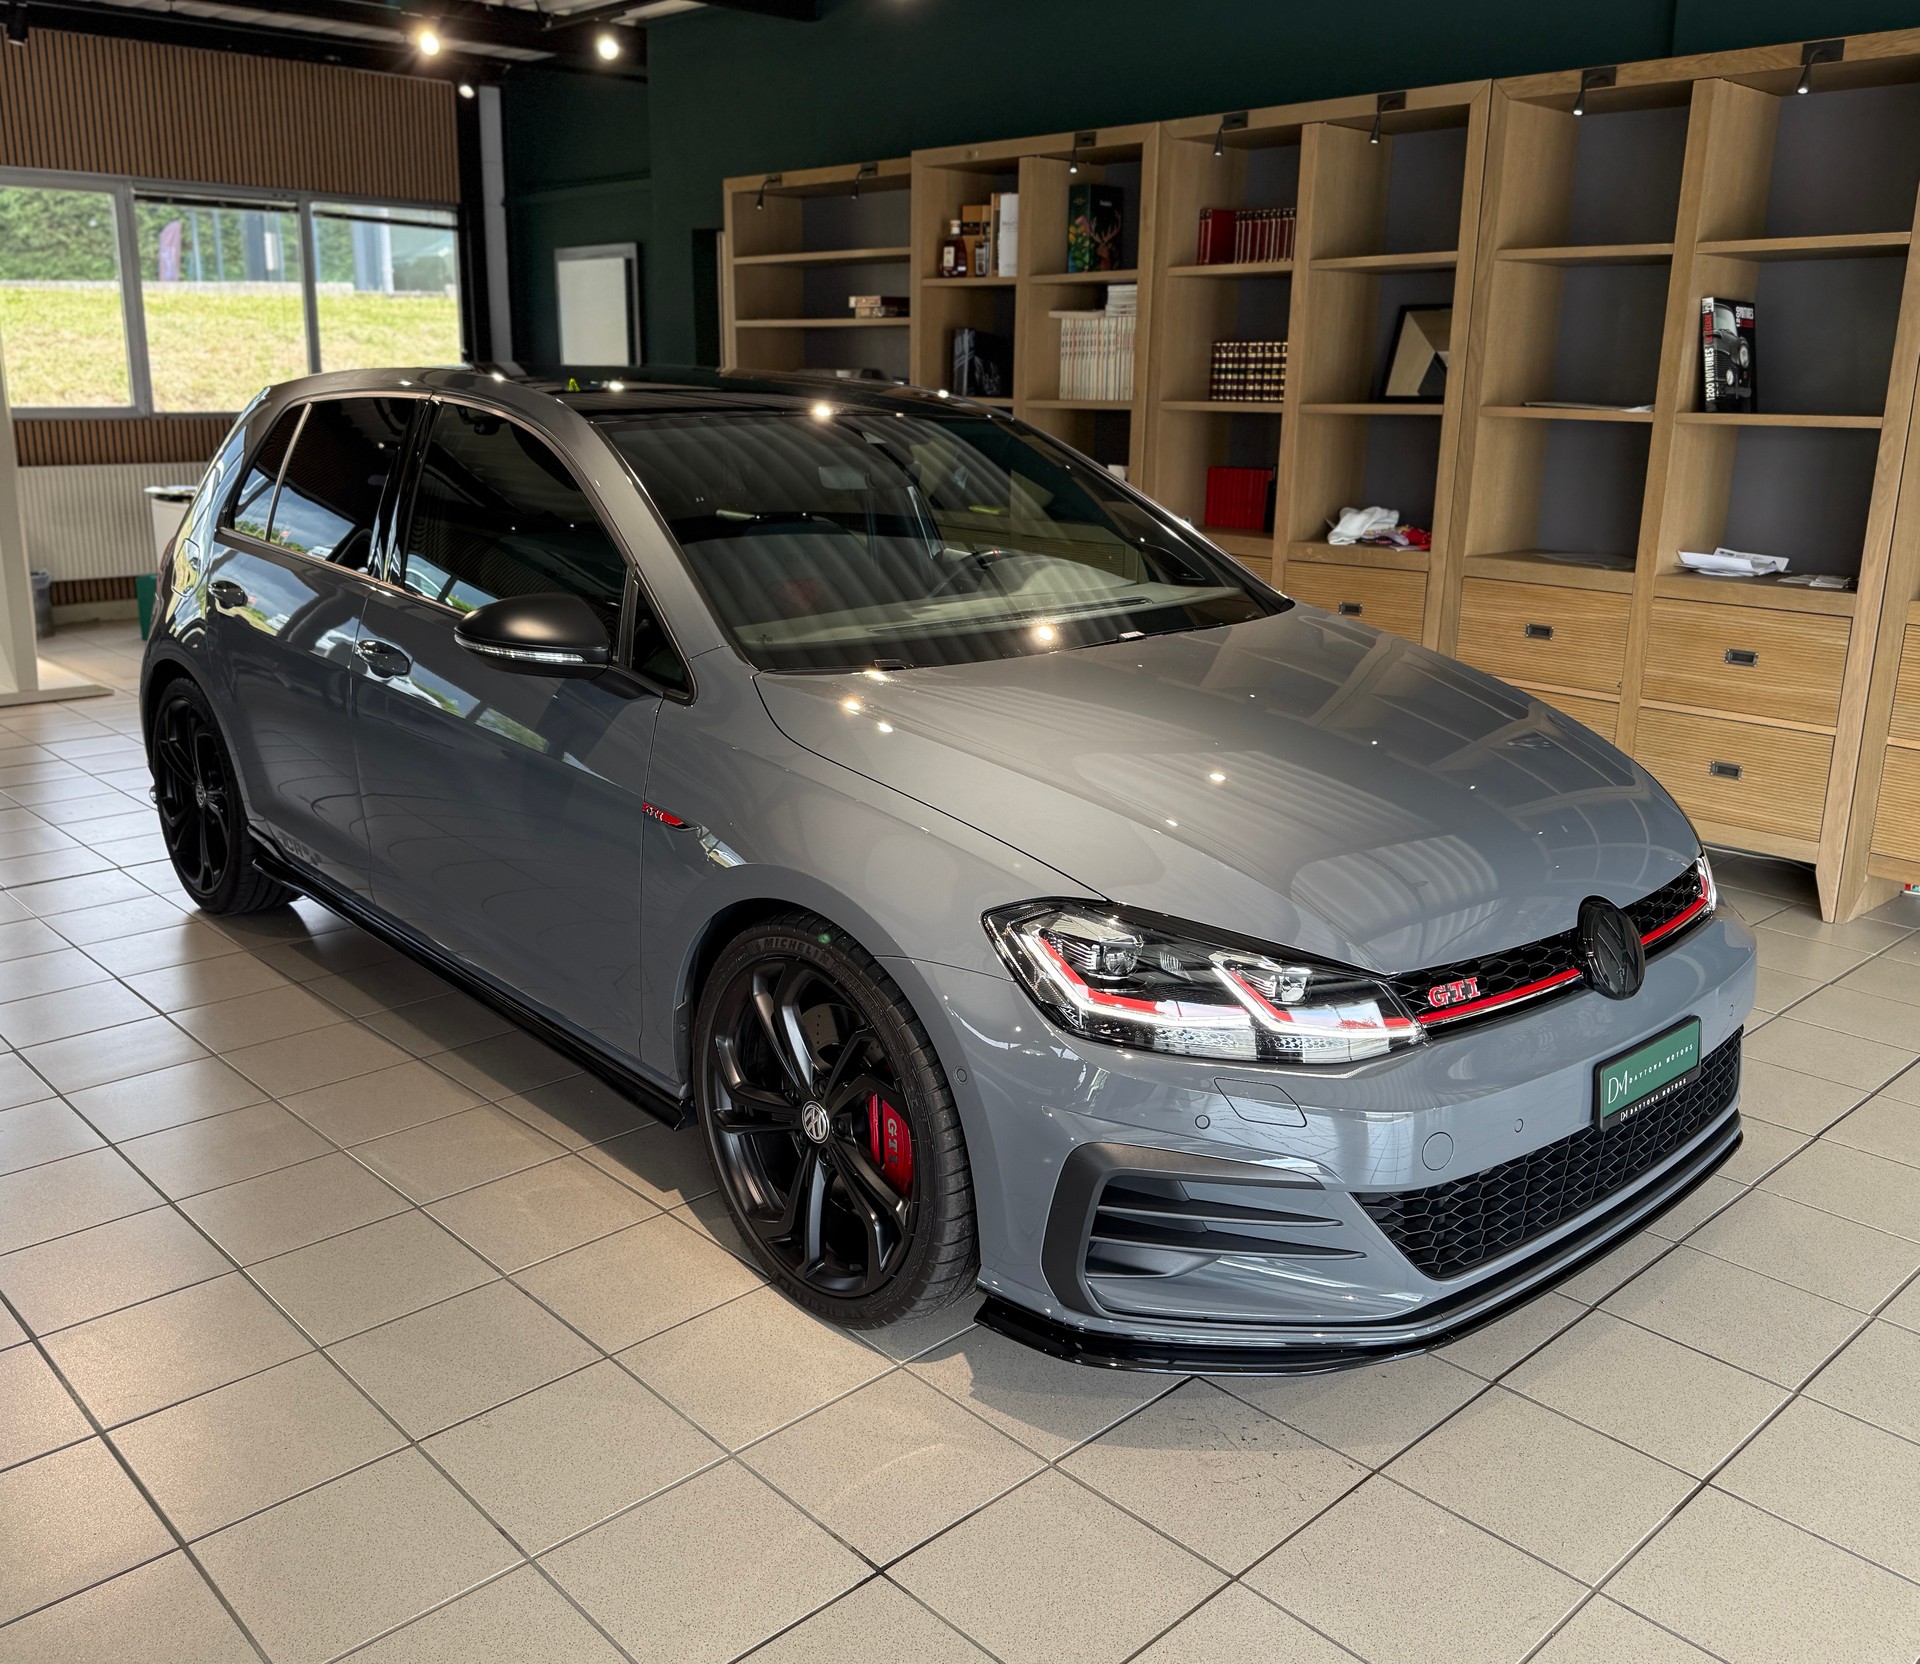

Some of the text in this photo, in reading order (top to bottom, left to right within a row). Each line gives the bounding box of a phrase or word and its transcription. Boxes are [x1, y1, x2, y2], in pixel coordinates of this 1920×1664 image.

[1704, 347, 1715, 384] VOITURES
[1706, 383, 1716, 402] 1200
[763, 937, 831, 967] MICHELIN
[1428, 977, 1481, 1007] GTI
[1608, 1043, 1693, 1104] DM DAYTONA MOTORS
[1630, 1094, 1659, 1115] DAYTONA
[1662, 1078, 1687, 1096] MOTORS
[887, 1118, 898, 1166] GTI
